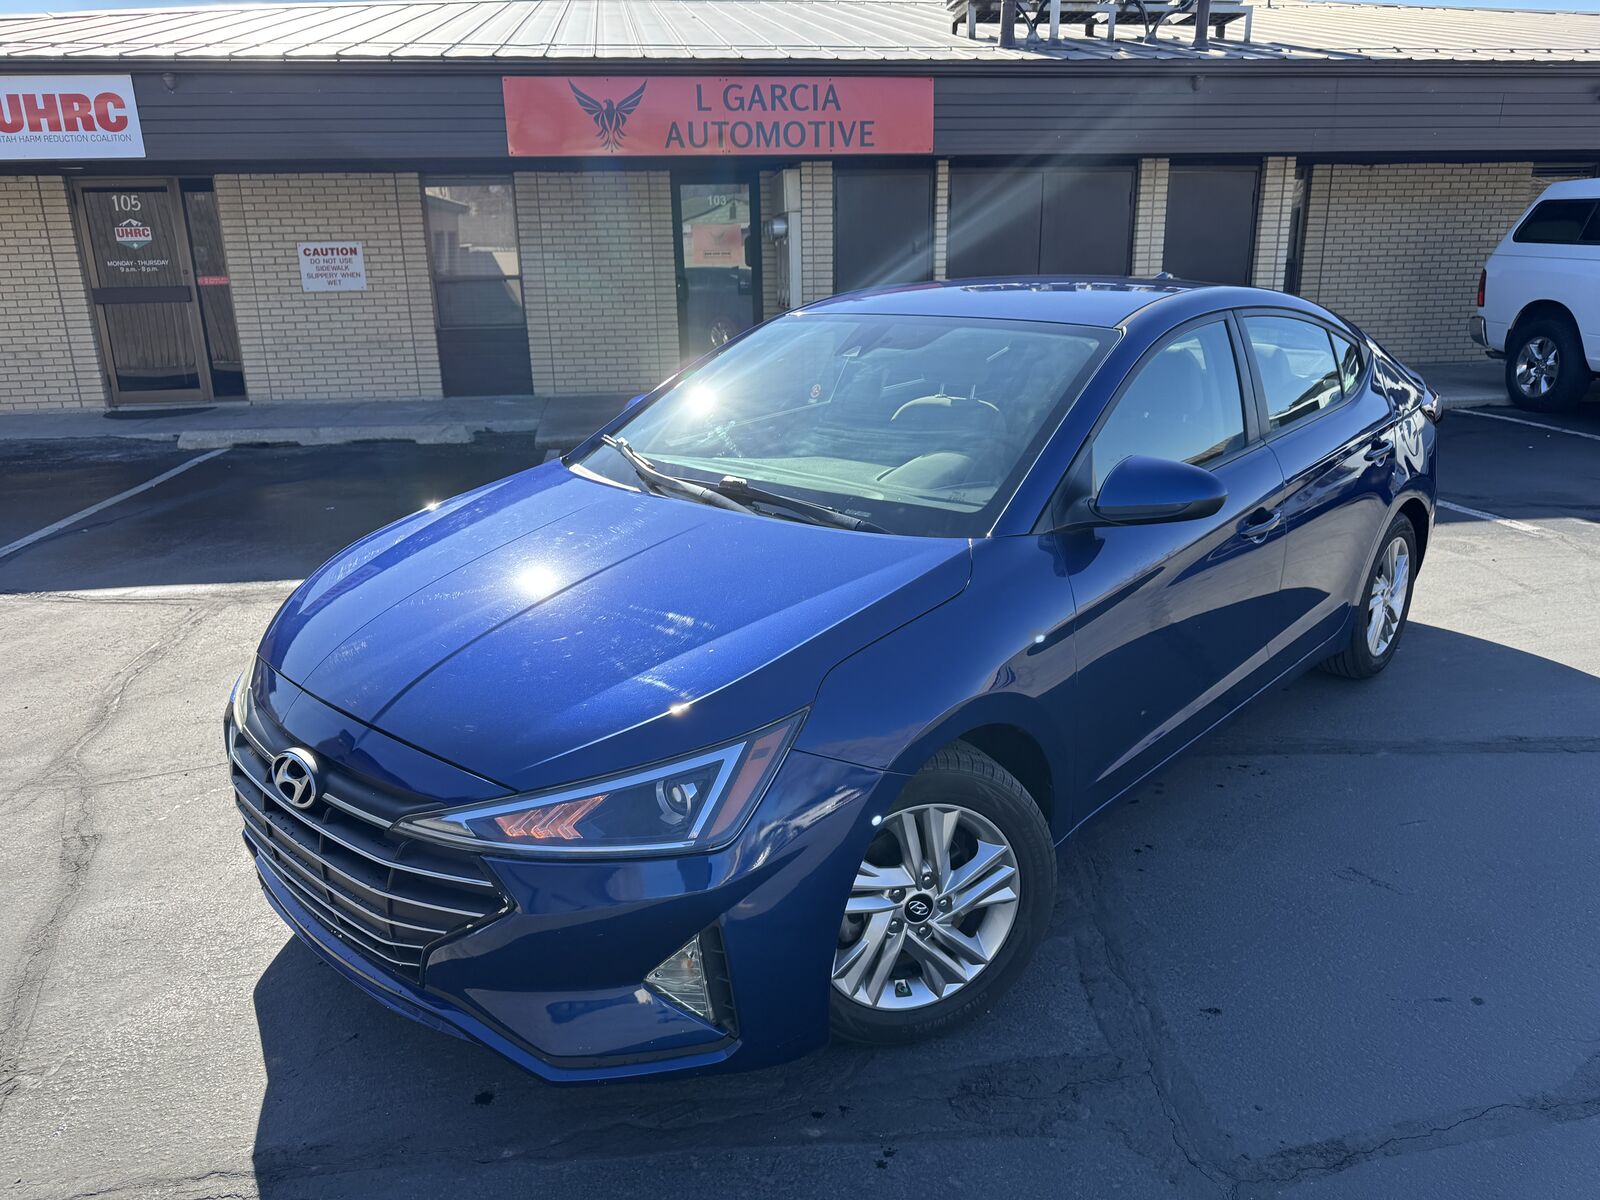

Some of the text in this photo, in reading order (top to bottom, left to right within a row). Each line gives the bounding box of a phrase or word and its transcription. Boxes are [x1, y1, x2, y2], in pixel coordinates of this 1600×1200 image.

[696, 84, 841, 112] L GARCIA
[0, 92, 129, 133] UHRC
[0, 135, 17, 143] TAH
[90, 134, 132, 142] COALITION
[665, 120, 875, 148] AUTOMOTIVE
[112, 195, 141, 211] 105
[707, 195, 727, 206] 103
[116, 228, 150, 238] UHRC
[303, 247, 358, 256] CAUTION
